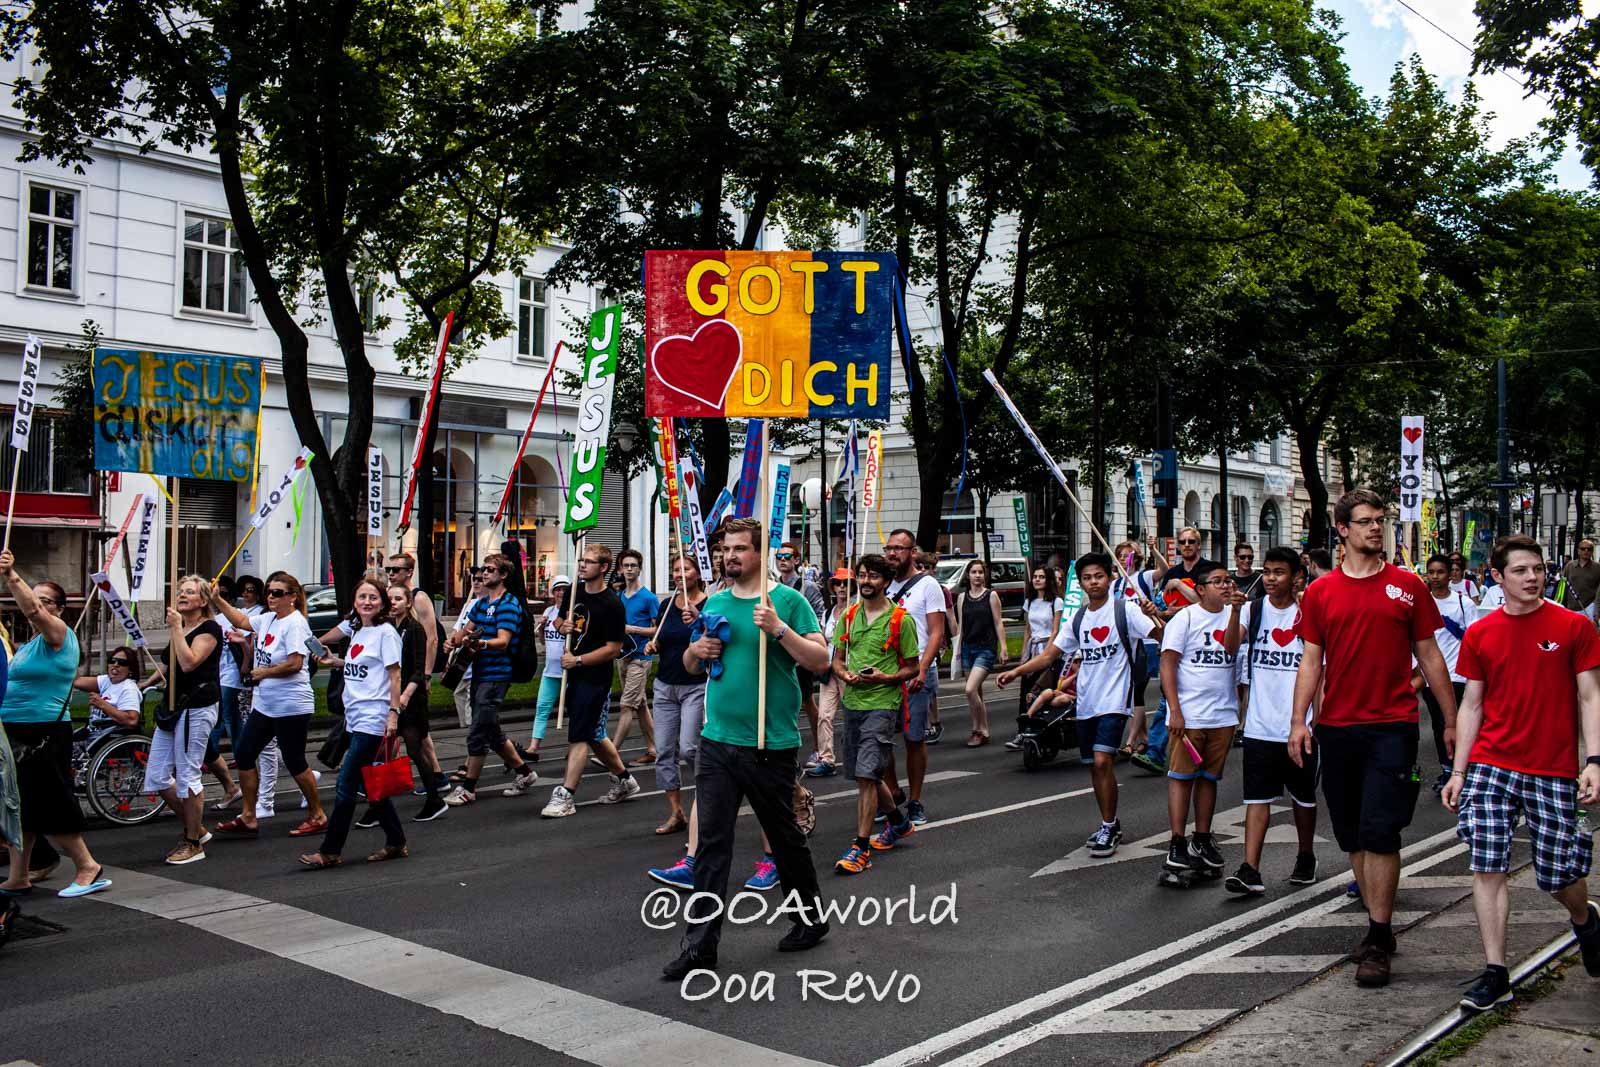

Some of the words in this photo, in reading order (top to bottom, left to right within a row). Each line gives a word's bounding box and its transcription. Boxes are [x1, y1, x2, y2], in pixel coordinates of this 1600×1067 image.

[686, 259, 880, 317] GOTT
[15, 343, 40, 436] JESUS
[101, 354, 255, 405] JESUS
[742, 358, 879, 407] DICH
[569, 312, 615, 522] JESUS
[190, 430, 252, 483] dig
[738, 431, 762, 517] JESUS
[863, 435, 878, 507] CARES
[1401, 455, 1420, 509] YOU
[259, 475, 292, 518] YOU
[369, 454, 382, 529] JESUS
[770, 470, 789, 540] RETTER
[132, 502, 153, 589] YEESU
[690, 503, 711, 571] DICH
[1016, 502, 1030, 552] JESUS
[109, 599, 143, 641] DICH
[1083, 630, 1090, 643] I
[1204, 632, 1212, 646] I
[344, 662, 369, 679] SUS
